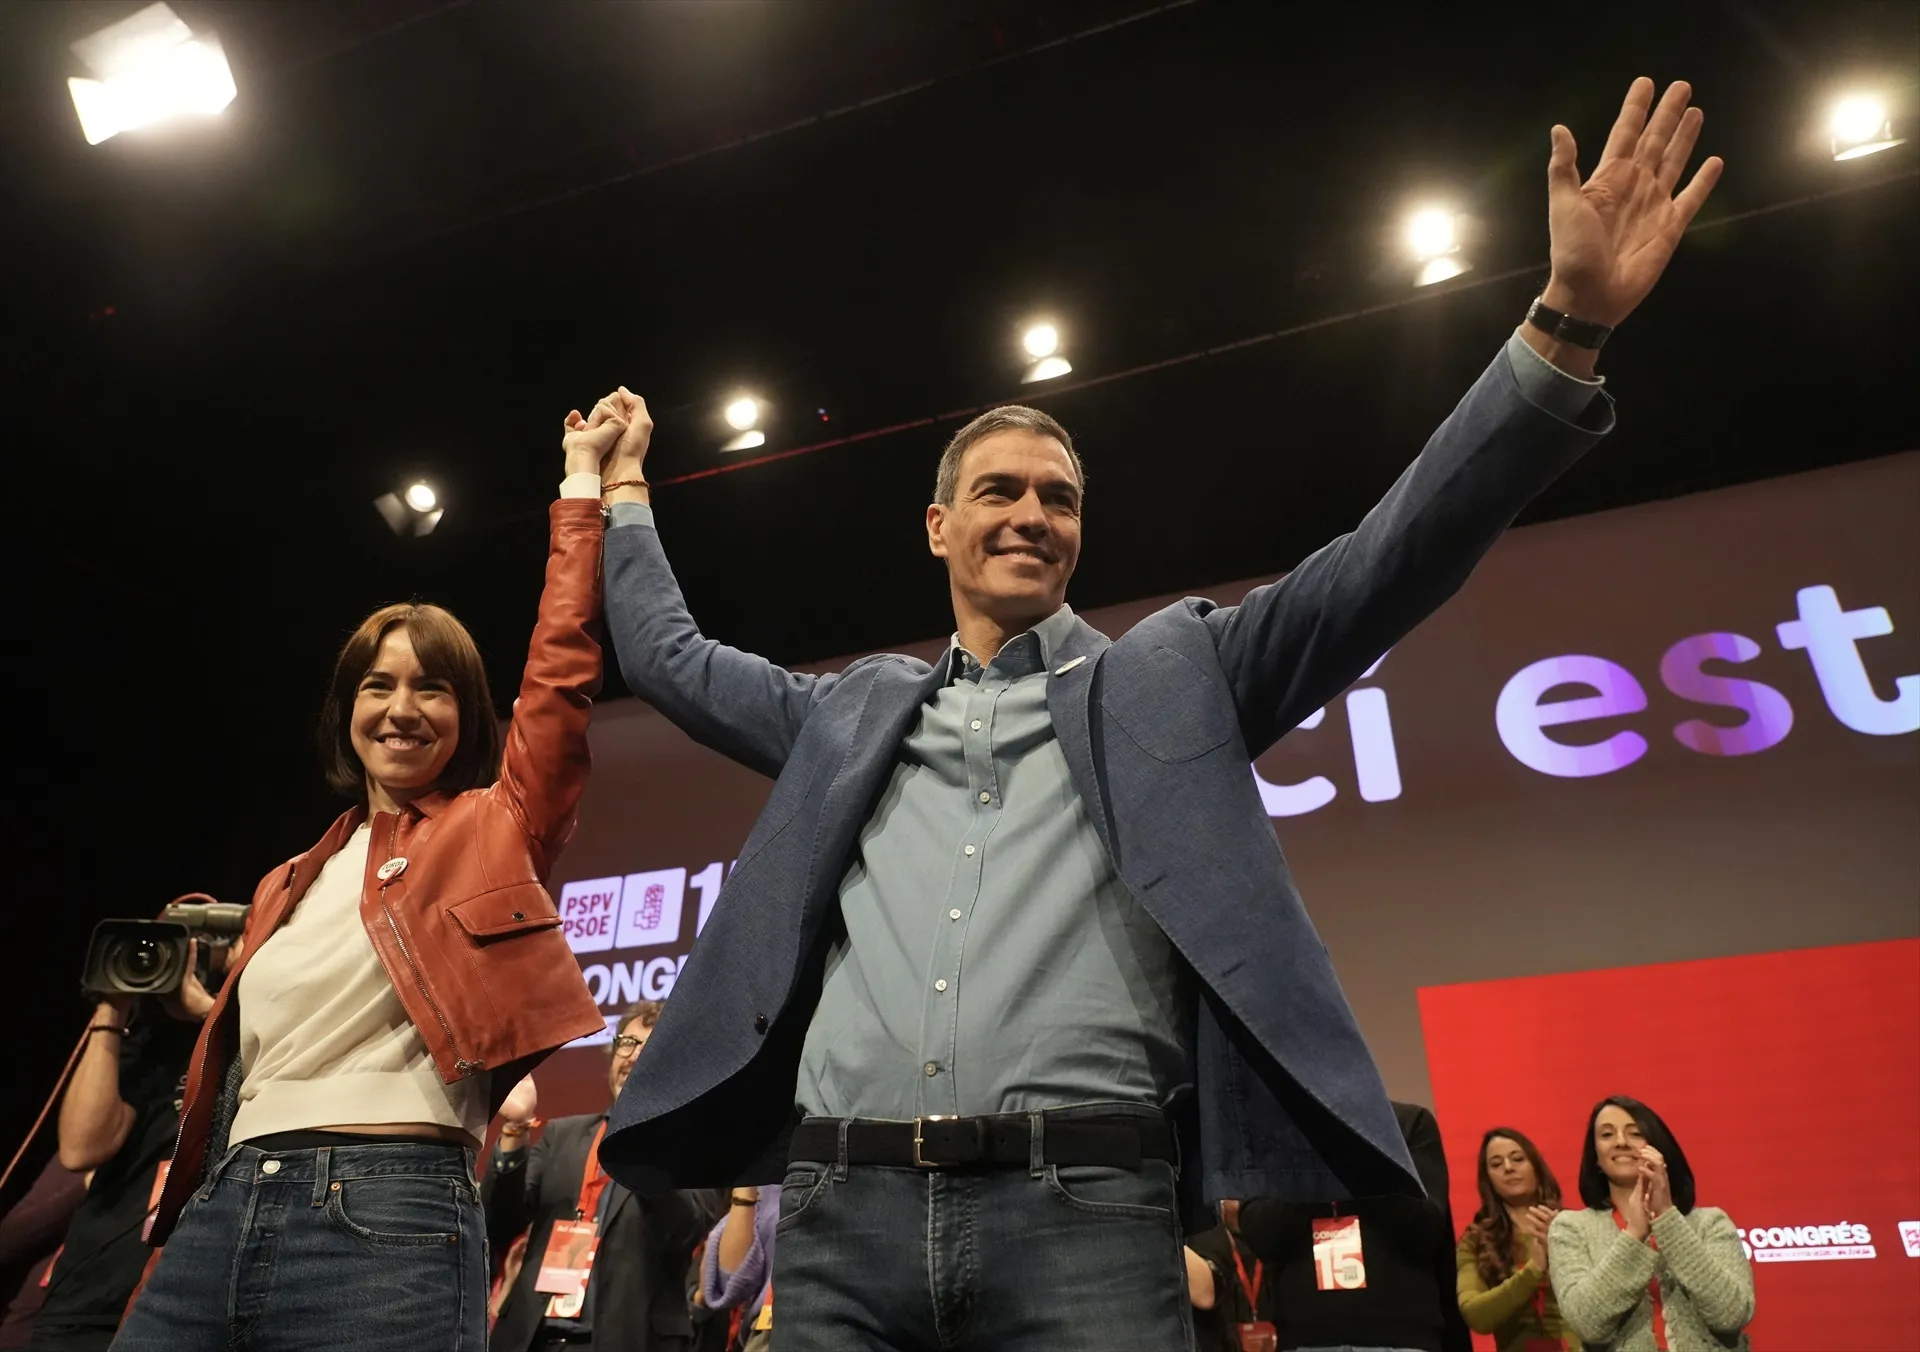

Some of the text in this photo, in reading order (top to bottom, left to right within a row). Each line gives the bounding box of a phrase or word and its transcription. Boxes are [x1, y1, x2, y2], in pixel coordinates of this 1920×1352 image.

[565, 892, 614, 916] PSPV
[690, 859, 738, 938] 1
[563, 914, 611, 938] PSOE
[582, 954, 690, 1006] ONG
[1749, 1221, 1871, 1249] CONGRÉS
[1313, 1239, 1366, 1290] 15
